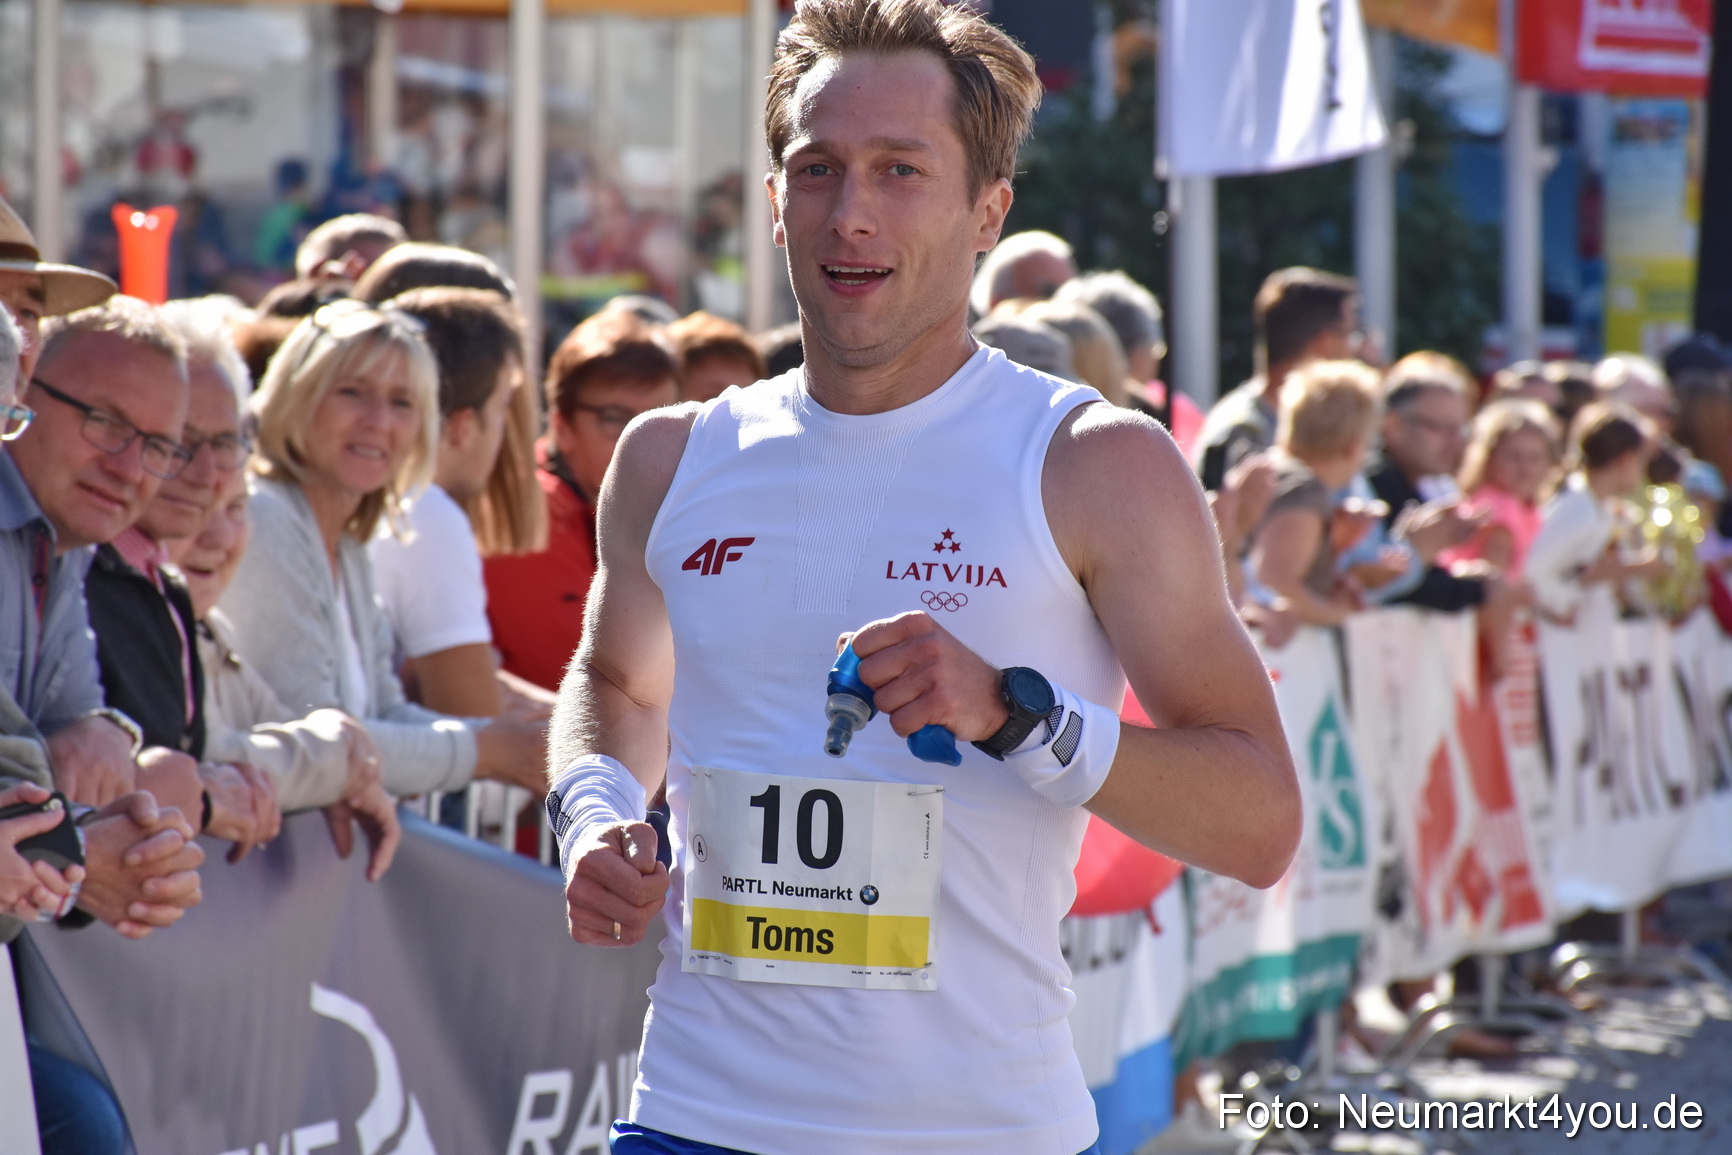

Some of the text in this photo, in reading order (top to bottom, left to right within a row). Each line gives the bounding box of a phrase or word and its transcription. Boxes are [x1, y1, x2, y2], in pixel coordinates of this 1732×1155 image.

[682, 537, 755, 576] 4F
[886, 560, 1008, 588] LATVIJA
[750, 784, 843, 869] 10
[722, 875, 853, 901] PARTL Neumarkt
[746, 916, 834, 955] Toms
